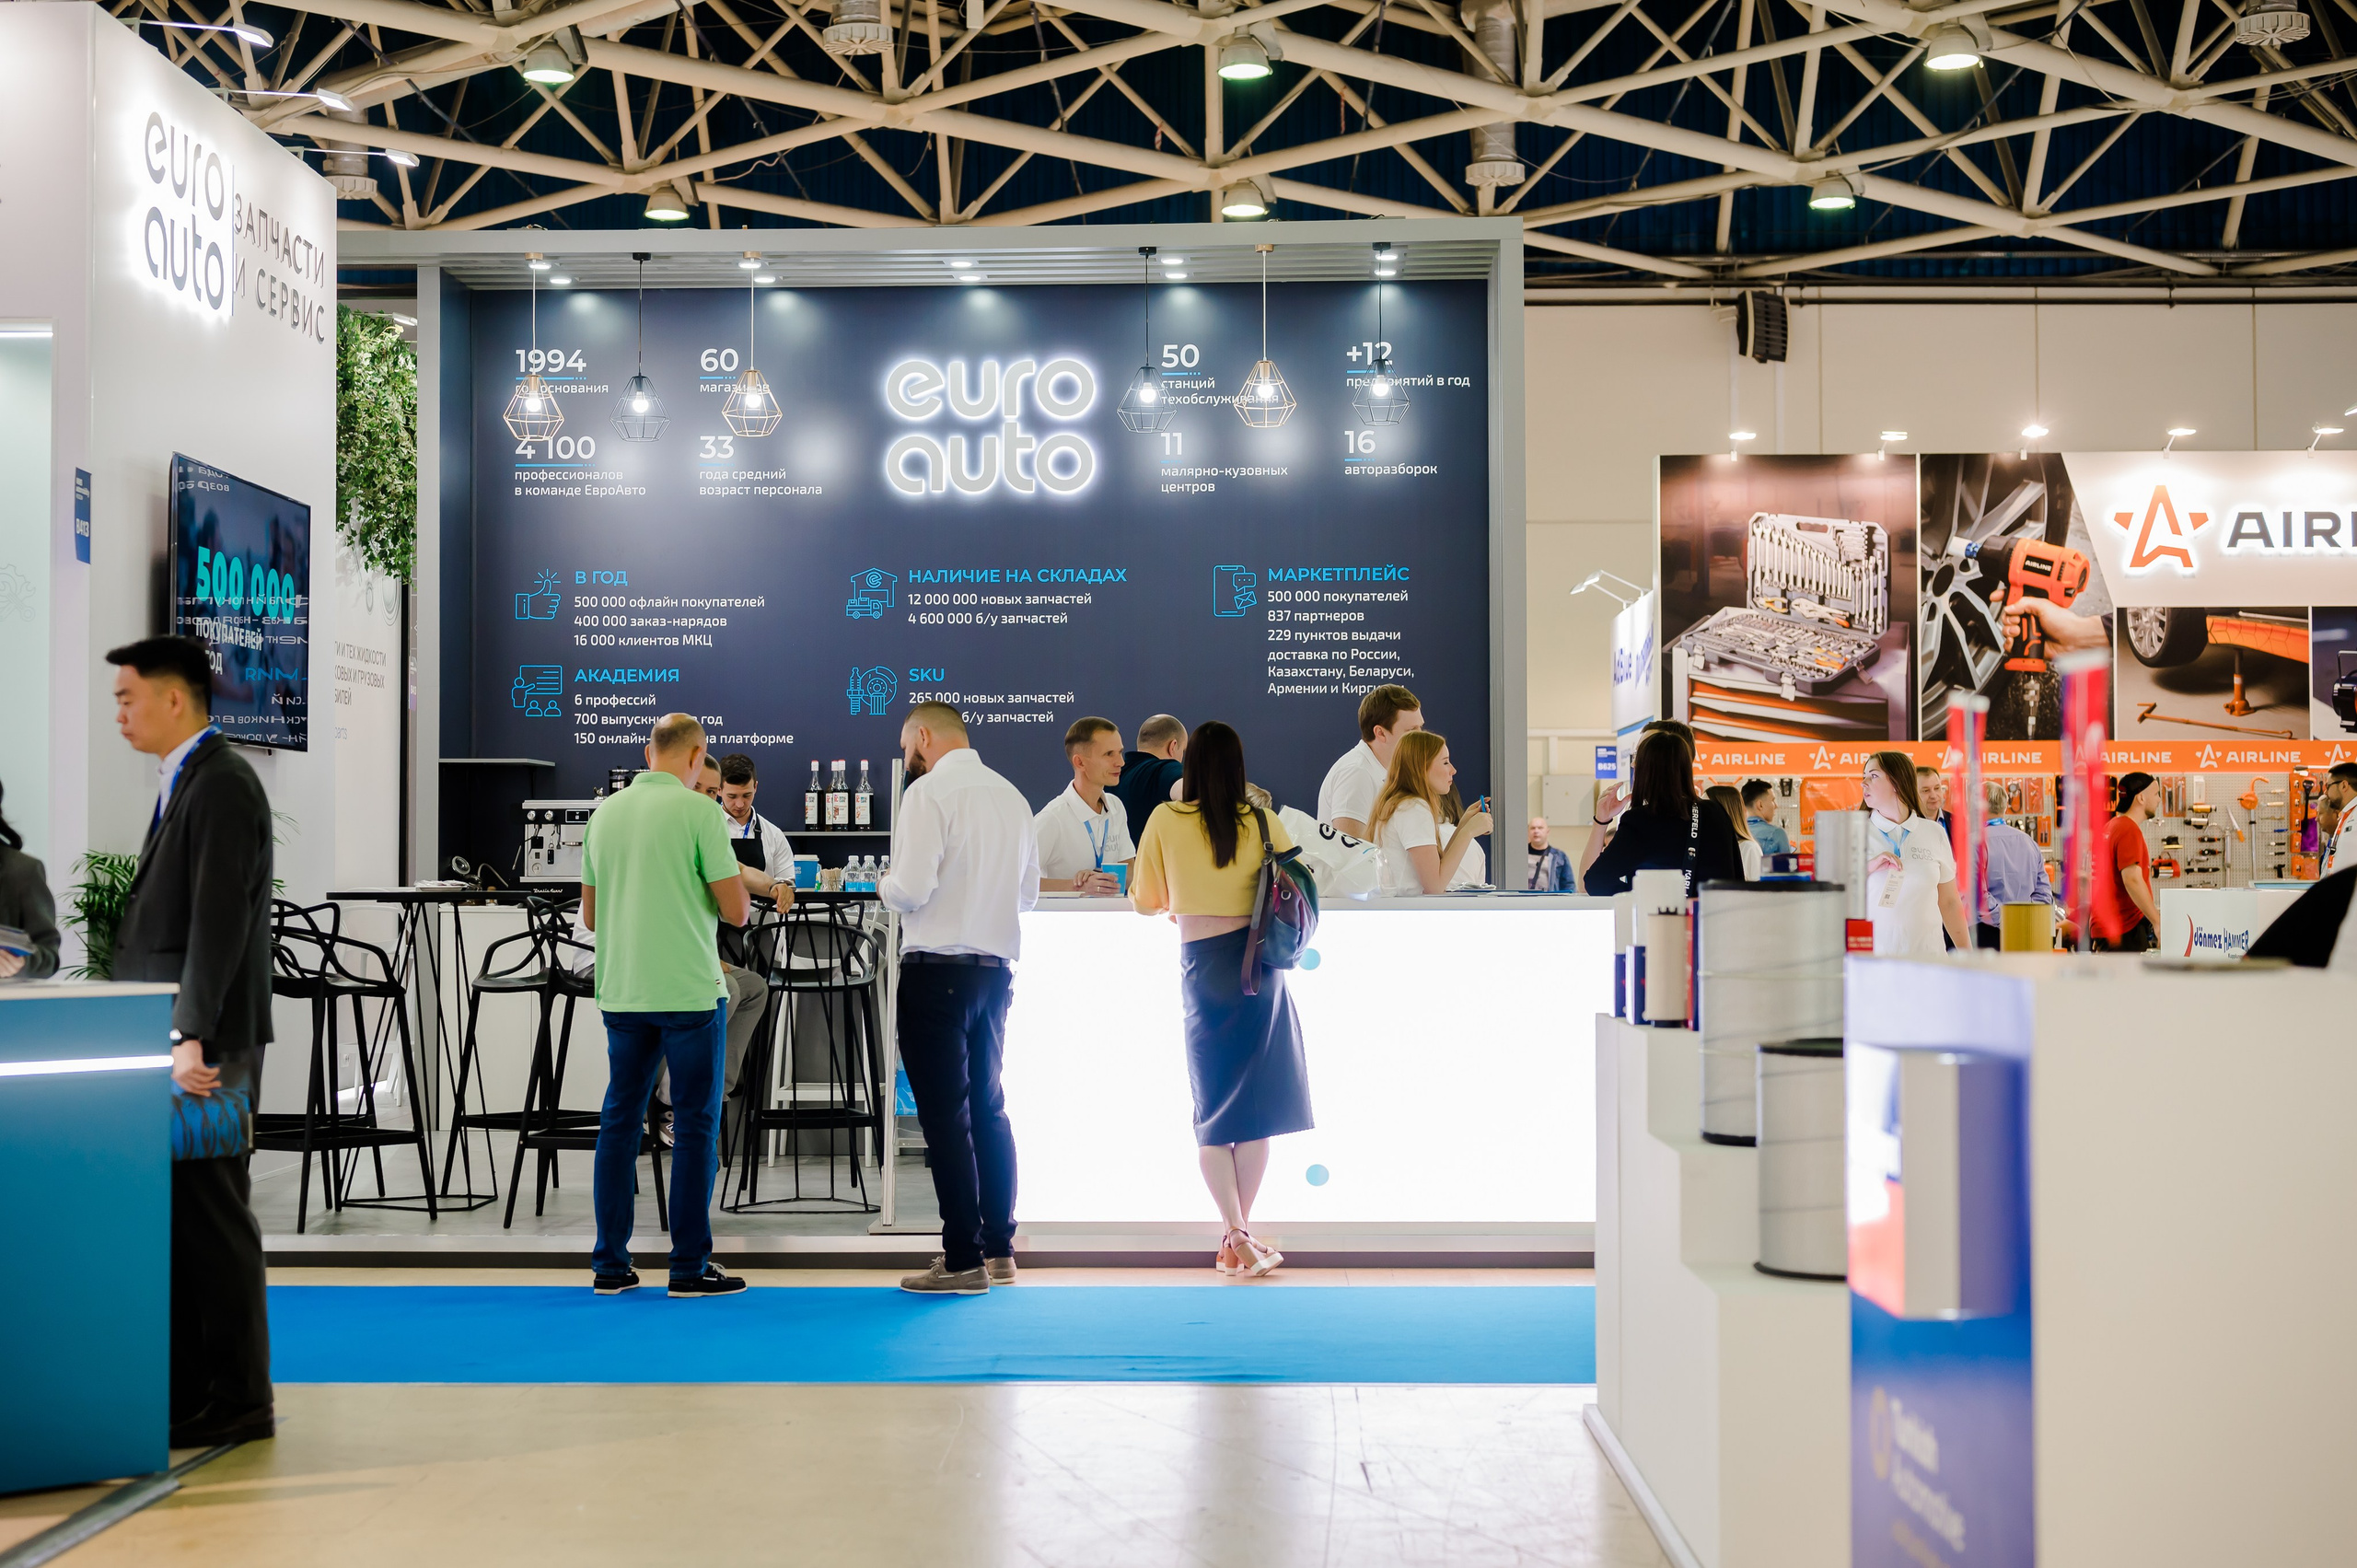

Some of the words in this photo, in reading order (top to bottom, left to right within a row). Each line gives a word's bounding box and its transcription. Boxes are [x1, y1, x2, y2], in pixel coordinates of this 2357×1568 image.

[145, 111, 225, 221] euro
[234, 192, 324, 288] ЗАПЧАСТИ
[145, 206, 225, 310] auto
[234, 252, 245, 298] И
[256, 268, 325, 344] СЕРВИС
[516, 349, 586, 373] 1994
[700, 348, 739, 372] 60
[1161, 343, 1200, 368] 50
[1346, 342, 1393, 366] +12
[540, 384, 609, 394] основания
[887, 359, 1095, 418] euro
[1161, 377, 1215, 390] станций
[1437, 377, 1445, 386] в
[1448, 377, 1471, 388] год
[699, 435, 734, 459] 33
[1161, 432, 1182, 456] 11
[1344, 430, 1376, 455] 16
[887, 422, 1094, 494] auto
[699, 470, 729, 482] года
[732, 468, 786, 482] средний
[1161, 464, 1288, 479] малярно-кузовных
[1344, 462, 1438, 476] авторазборок
[515, 470, 623, 484] профессионалов
[515, 487, 522, 496] в
[525, 485, 582, 498] команде
[585, 484, 646, 498] ЕвроАвто
[699, 485, 751, 497] возраст
[753, 484, 823, 497] персонала
[1161, 481, 1215, 494] центров
[2226, 511, 2357, 549] AIR
[1268, 563, 1410, 582] МАРКЕТПЛЕЙС
[2025, 559, 2052, 572] AIRLINE
[575, 571, 586, 585] В
[593, 571, 628, 587] ГОД
[909, 569, 1001, 584] НАЛИЧИЕ
[1005, 569, 1033, 583] НА
[1037, 568, 1128, 585] СКЛАДАХ
[196, 545, 244, 610] 500
[250, 563, 296, 625] 000
[575, 597, 599, 608] 500
[602, 597, 626, 608] 000
[629, 596, 678, 610] офлайн
[681, 596, 765, 610] покупателей
[908, 594, 922, 605] 12
[924, 594, 949, 605] 000
[953, 594, 978, 605] 000
[981, 595, 1022, 605] новых
[1025, 592, 1092, 605] запчастей
[1267, 590, 1292, 602] 500
[1295, 590, 1320, 602] 000
[1323, 589, 1409, 605] покупателей
[575, 615, 599, 627] 400
[602, 615, 627, 627] 000
[630, 616, 727, 630] заказ-нарядов
[908, 612, 917, 624] 4
[920, 612, 945, 624] 600
[947, 612, 972, 624] 000
[975, 612, 999, 627] б/у
[1001, 611, 1068, 624] запчастей
[1267, 610, 1292, 622] 837
[1294, 610, 1364, 624] партнеров
[195, 616, 262, 651] ПОКУПАТЕЛЕЙ
[575, 634, 587, 646] 16
[590, 634, 615, 646] 000
[619, 636, 679, 646] клиентов
[682, 634, 713, 648] МКЦ
[1267, 629, 1292, 641] 229
[1295, 631, 1348, 644] пунктов
[1352, 630, 1401, 643] выдачи
[1267, 650, 1329, 662] доставка
[1332, 650, 1348, 660] по
[1351, 648, 1400, 662] России,
[575, 668, 680, 685] АКАДЕМИЯ
[909, 668, 945, 682] SKU
[1268, 666, 1346, 679] Казахстану,
[1349, 665, 1415, 679] Беларуси,
[1267, 682, 1328, 696] Армении
[1330, 684, 1339, 694] и
[575, 693, 582, 705] 6
[586, 693, 656, 708] профессий
[909, 691, 933, 703] 265
[935, 691, 960, 703] 000
[963, 693, 1005, 703] новых
[1007, 691, 1074, 704] запчастей
[574, 713, 598, 725] 700
[701, 715, 724, 726] год
[961, 711, 984, 725] б/у
[987, 711, 1054, 723] запчастей
[574, 732, 596, 744] 150
[598, 732, 651, 744] онлайн-
[720, 733, 794, 747] платформе
[1711, 752, 1786, 766] AIRLINE
[2099, 751, 2172, 764] AIRLINE
[2225, 750, 2301, 764] AIRLINE
[2194, 926, 2223, 949] dönmez
[2223, 927, 2249, 953] HAMMER
